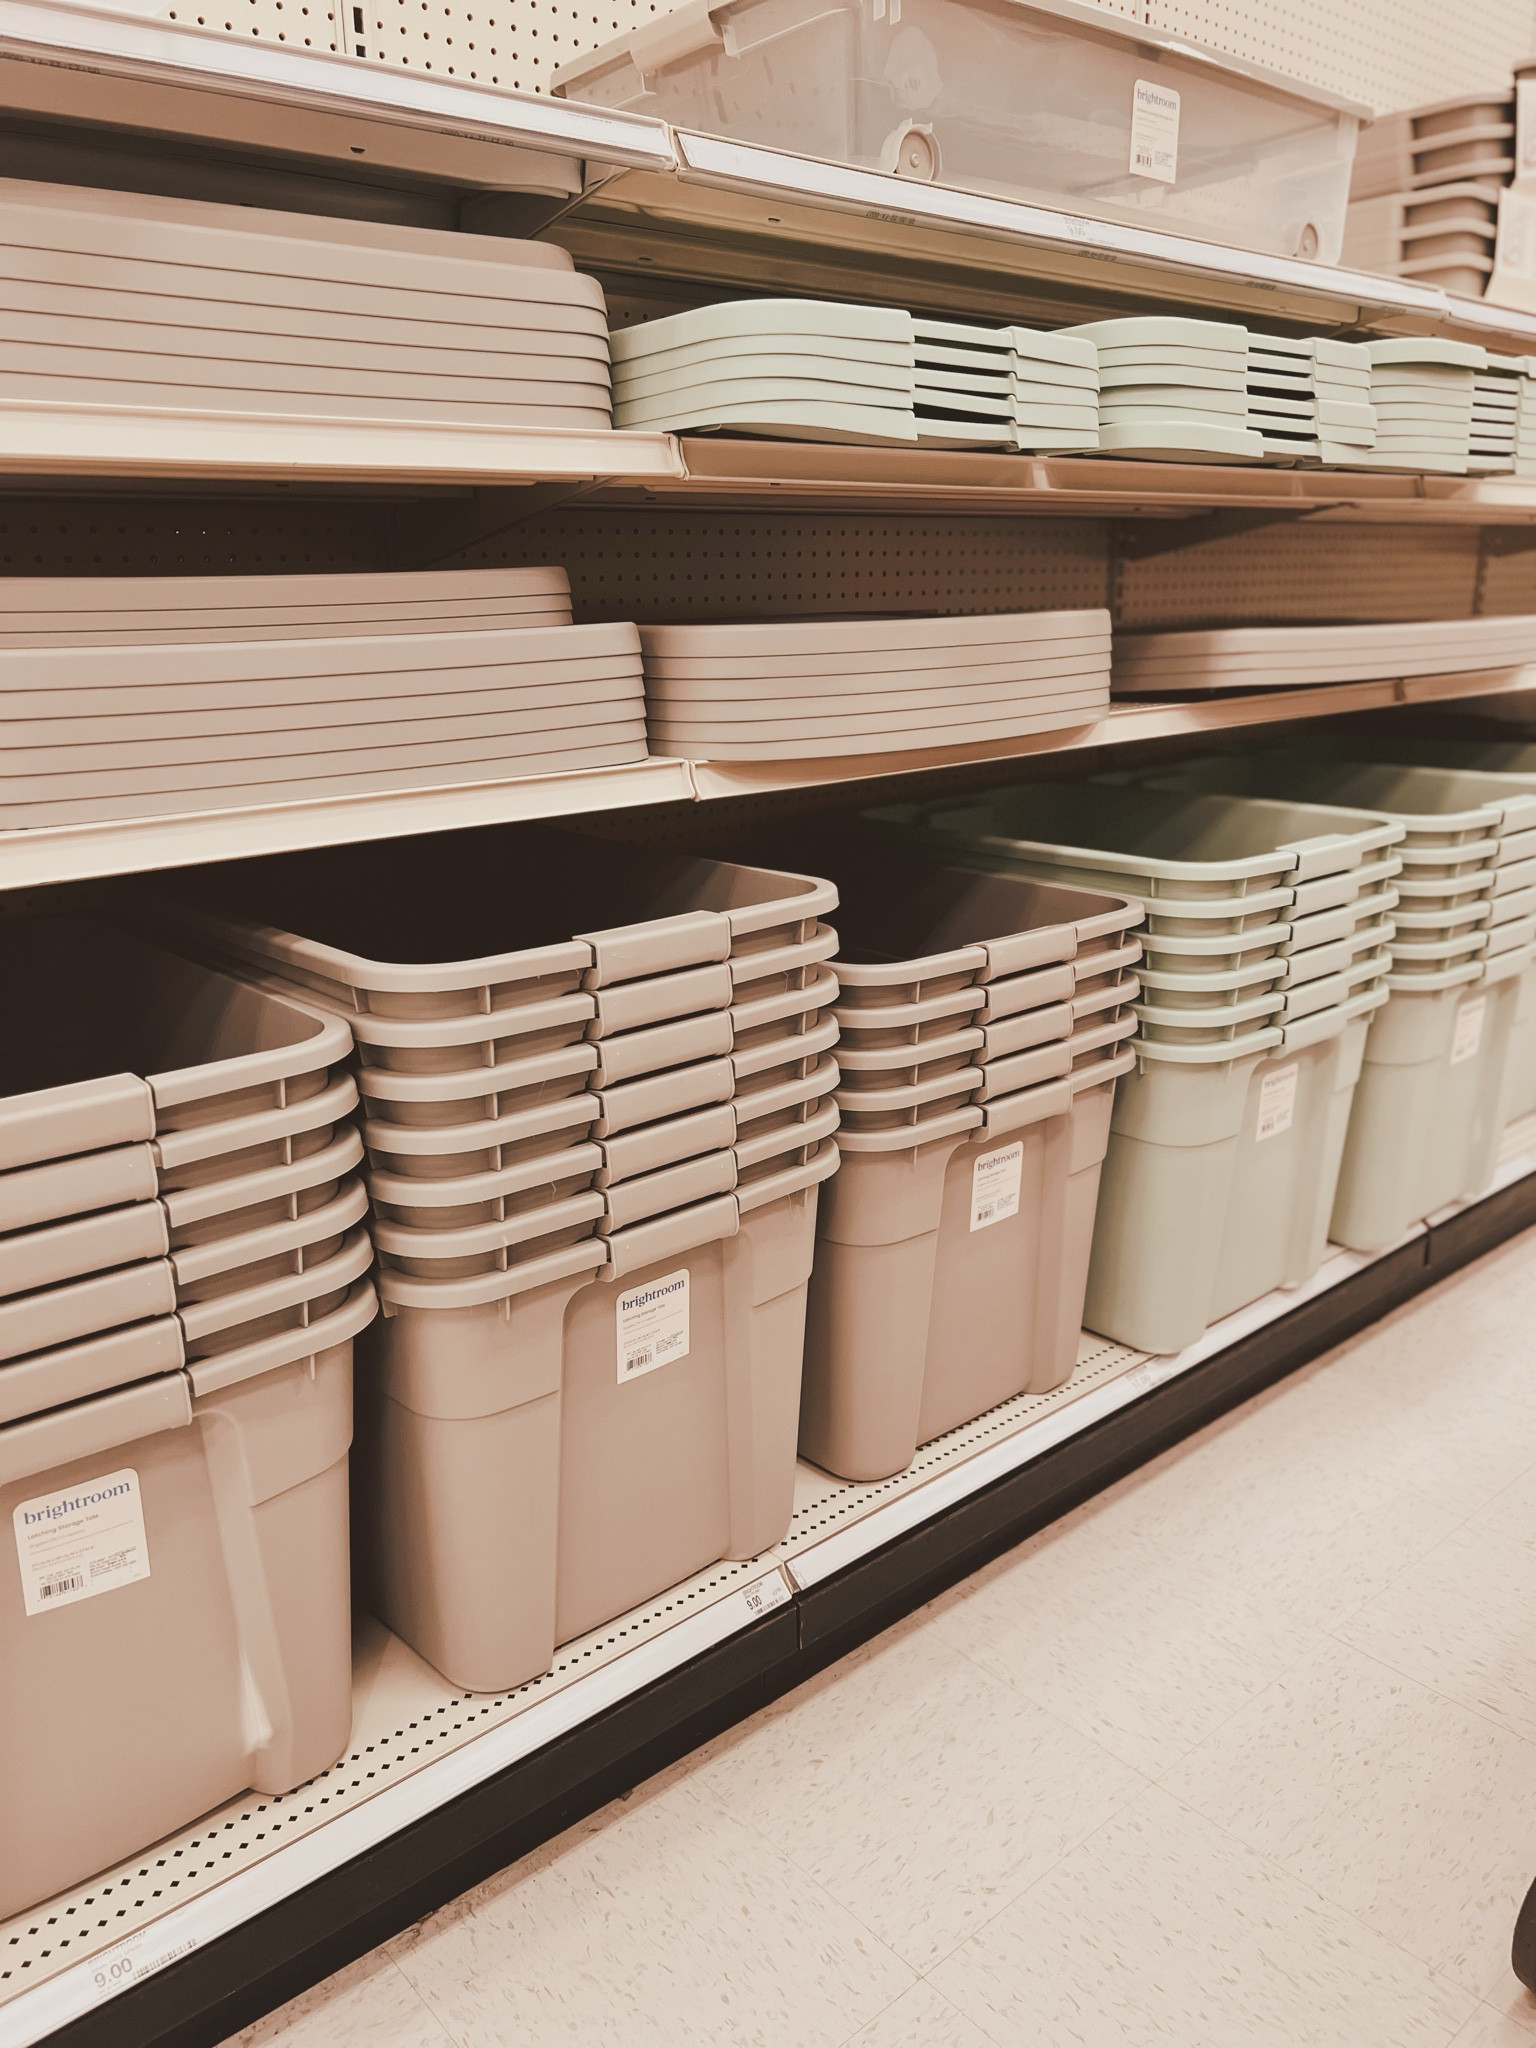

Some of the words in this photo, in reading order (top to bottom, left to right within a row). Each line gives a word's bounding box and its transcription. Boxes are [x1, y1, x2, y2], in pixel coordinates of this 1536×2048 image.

[1137, 88, 1177, 110] brightroom
[977, 1150, 1020, 1171] brightroom
[622, 1279, 685, 1311] brightroom
[24, 1482, 131, 1525] brightroom
[27, 1528, 57, 1541] Latching
[58, 1518, 84, 1531] Storage
[85, 1513, 99, 1522] Tote
[746, 1595, 763, 1610] 9.00
[94, 1957, 133, 1988] 9.00
